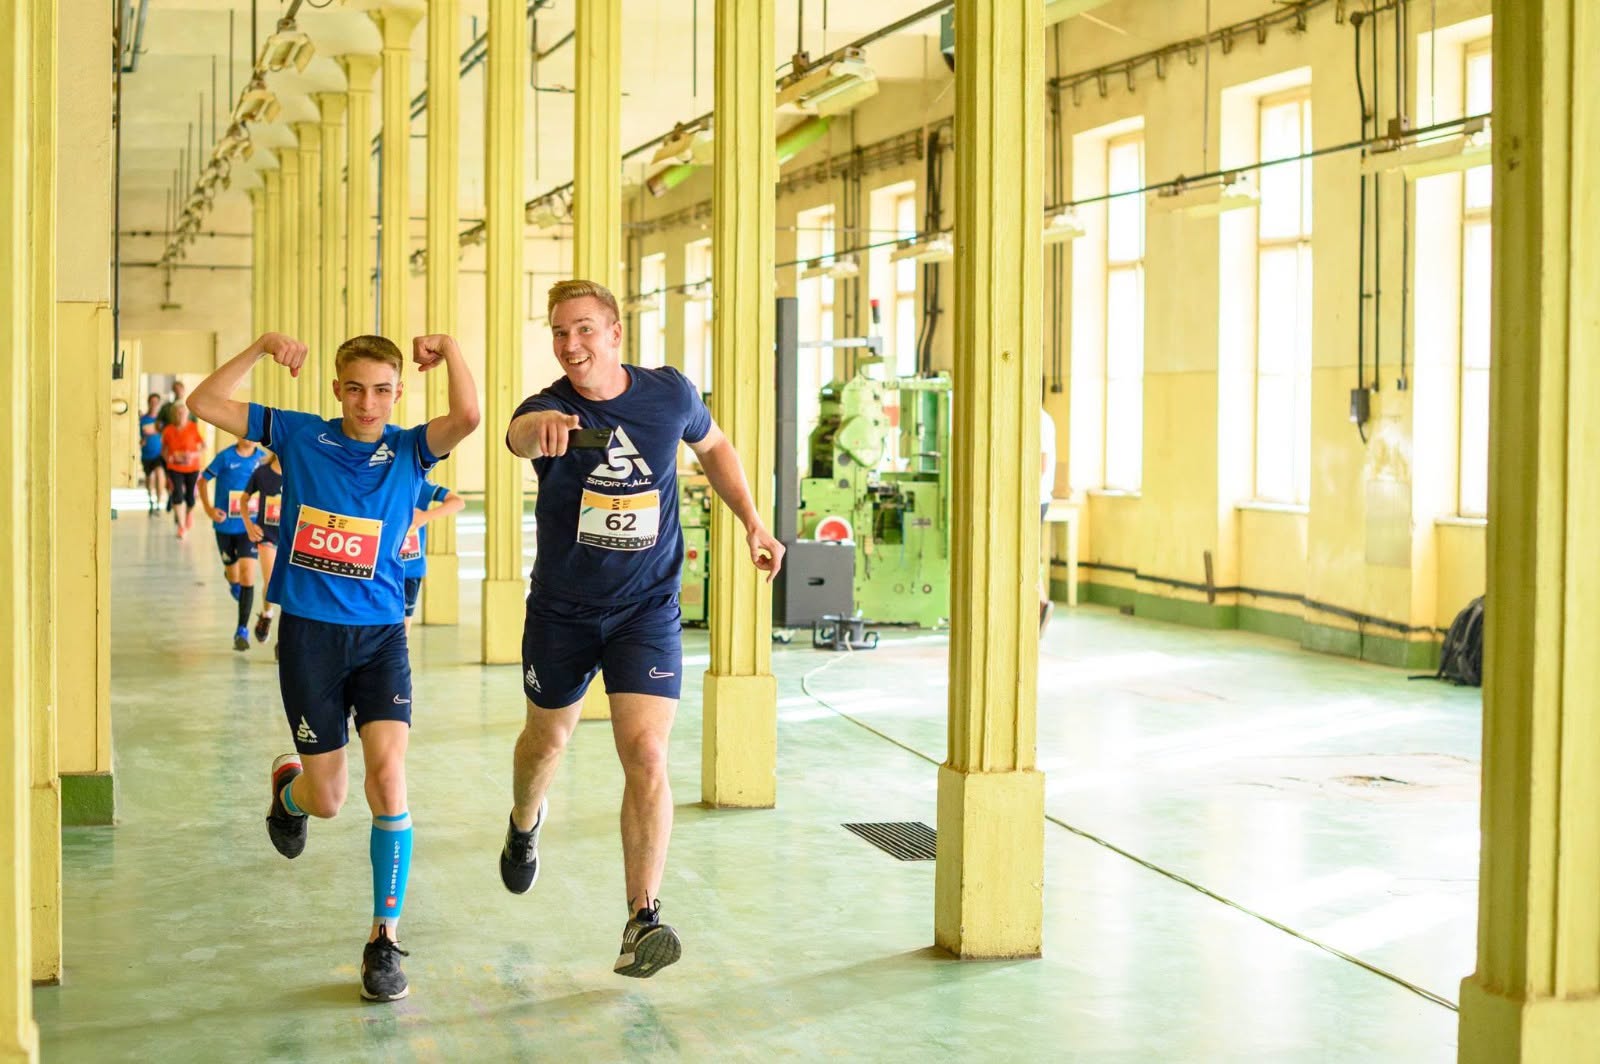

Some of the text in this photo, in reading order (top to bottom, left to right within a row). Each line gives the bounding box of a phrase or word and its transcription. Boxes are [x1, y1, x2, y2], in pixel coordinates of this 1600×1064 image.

[586, 477, 652, 488] SPORT-ALL
[605, 513, 637, 531] 62
[308, 527, 363, 557] 506
